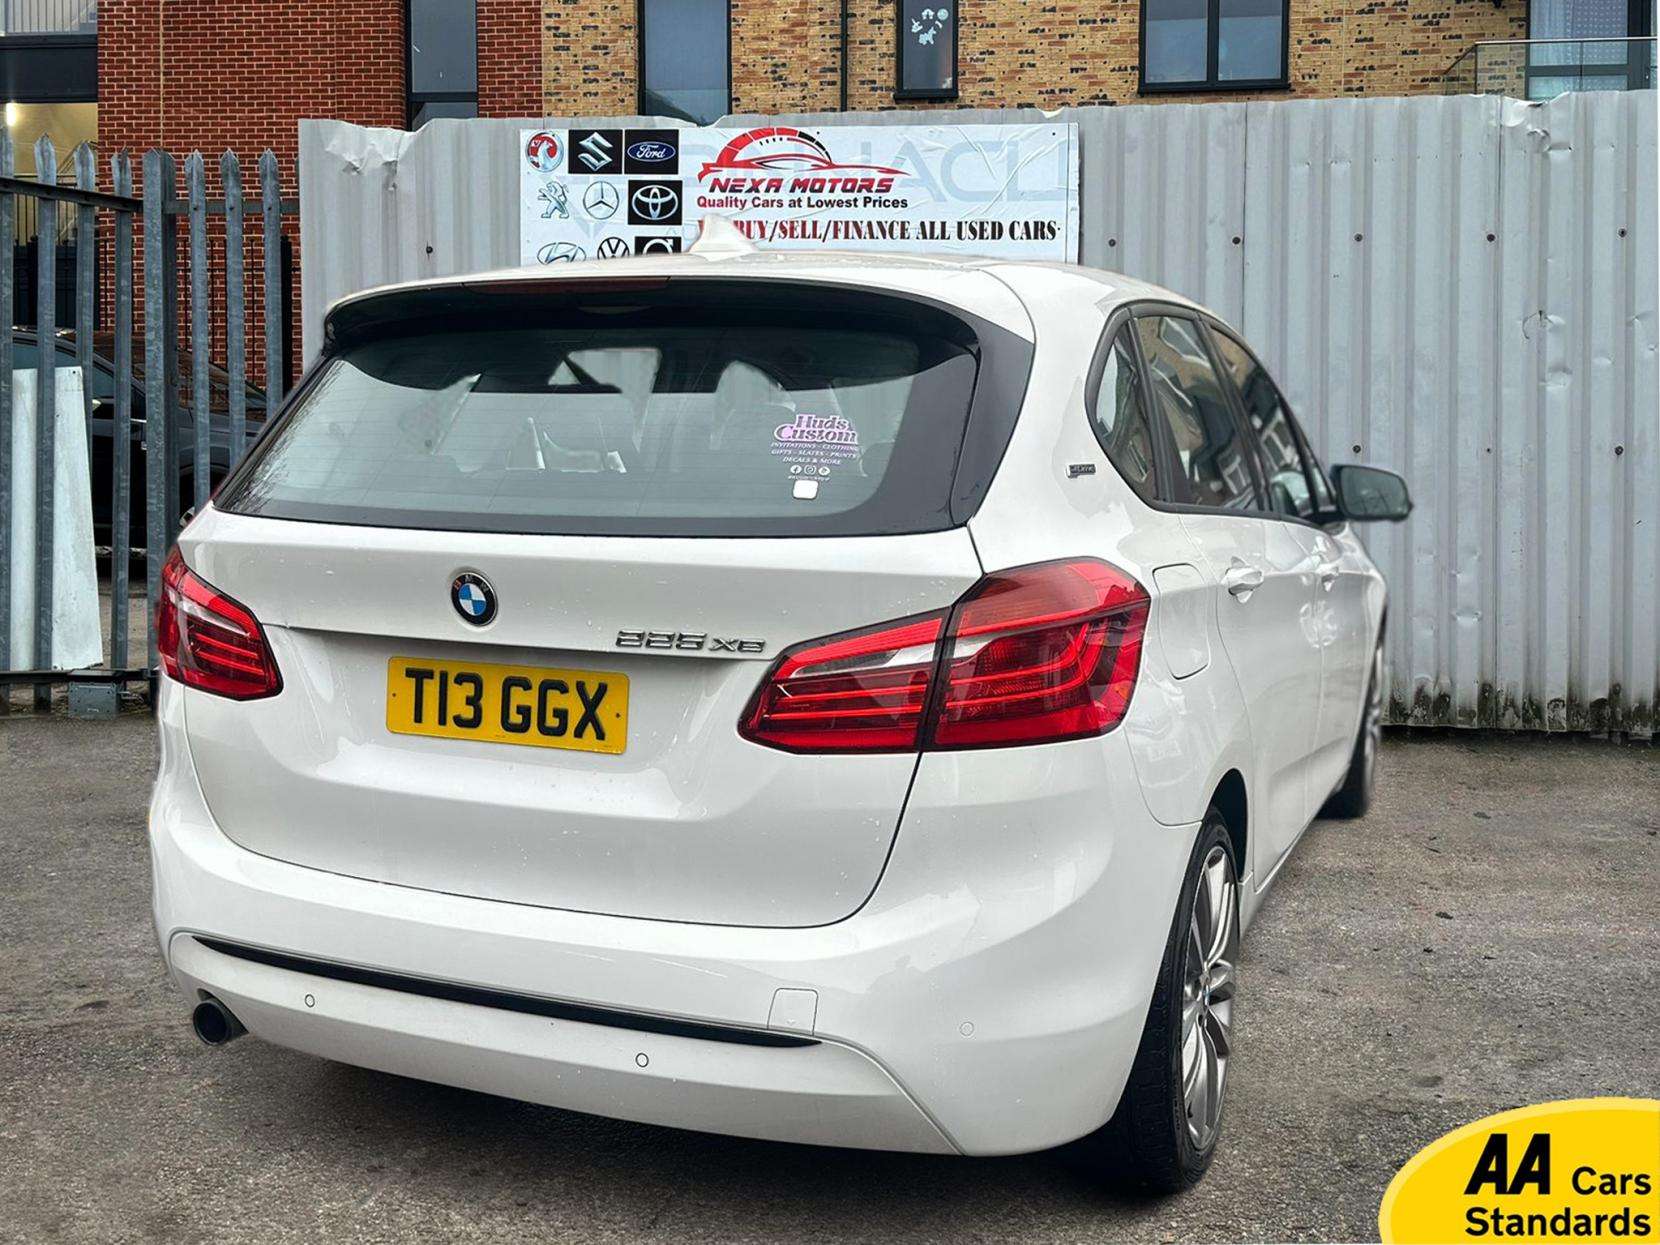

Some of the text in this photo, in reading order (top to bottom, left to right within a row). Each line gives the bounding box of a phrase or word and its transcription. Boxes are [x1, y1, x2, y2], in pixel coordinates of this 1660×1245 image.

[636, 144, 667, 159] Ford
[709, 178, 895, 194] NEXA MOTORS
[697, 195, 908, 210] Quality Cars at Lowest Prices
[917, 220, 951, 241] ALL
[956, 220, 1003, 241] USED
[1008, 220, 1057, 241] CARS
[774, 423, 859, 444] Custom
[771, 441, 817, 450] INVITATIONS
[405, 667, 608, 741] T13 GGX
